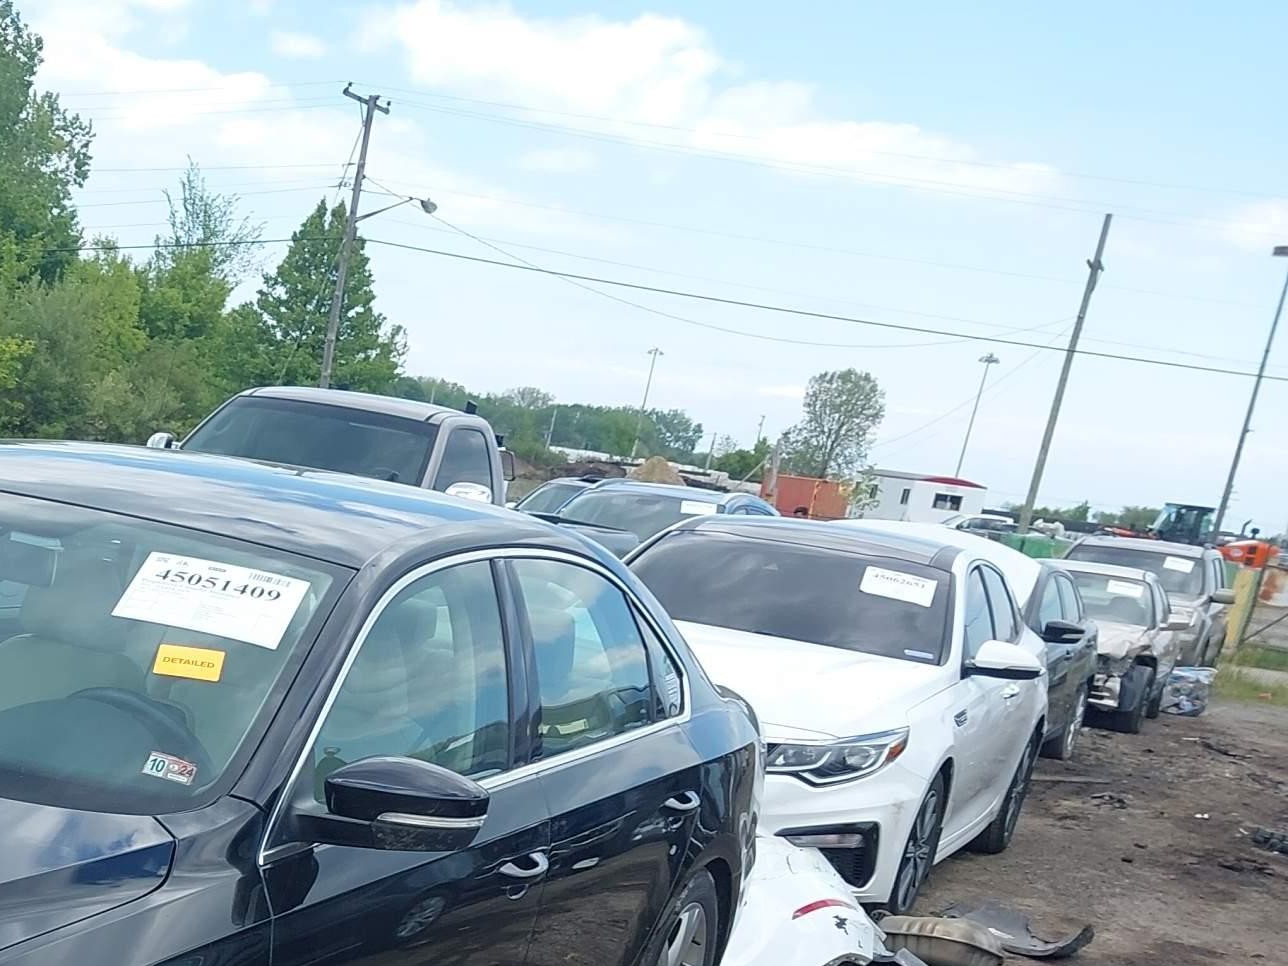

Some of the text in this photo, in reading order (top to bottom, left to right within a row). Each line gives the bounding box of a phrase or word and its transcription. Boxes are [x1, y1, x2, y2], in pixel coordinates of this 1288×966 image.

[155, 569, 281, 601] 45051409
[162, 655, 216, 670] DETAILED
[149, 757, 166, 773] 10
